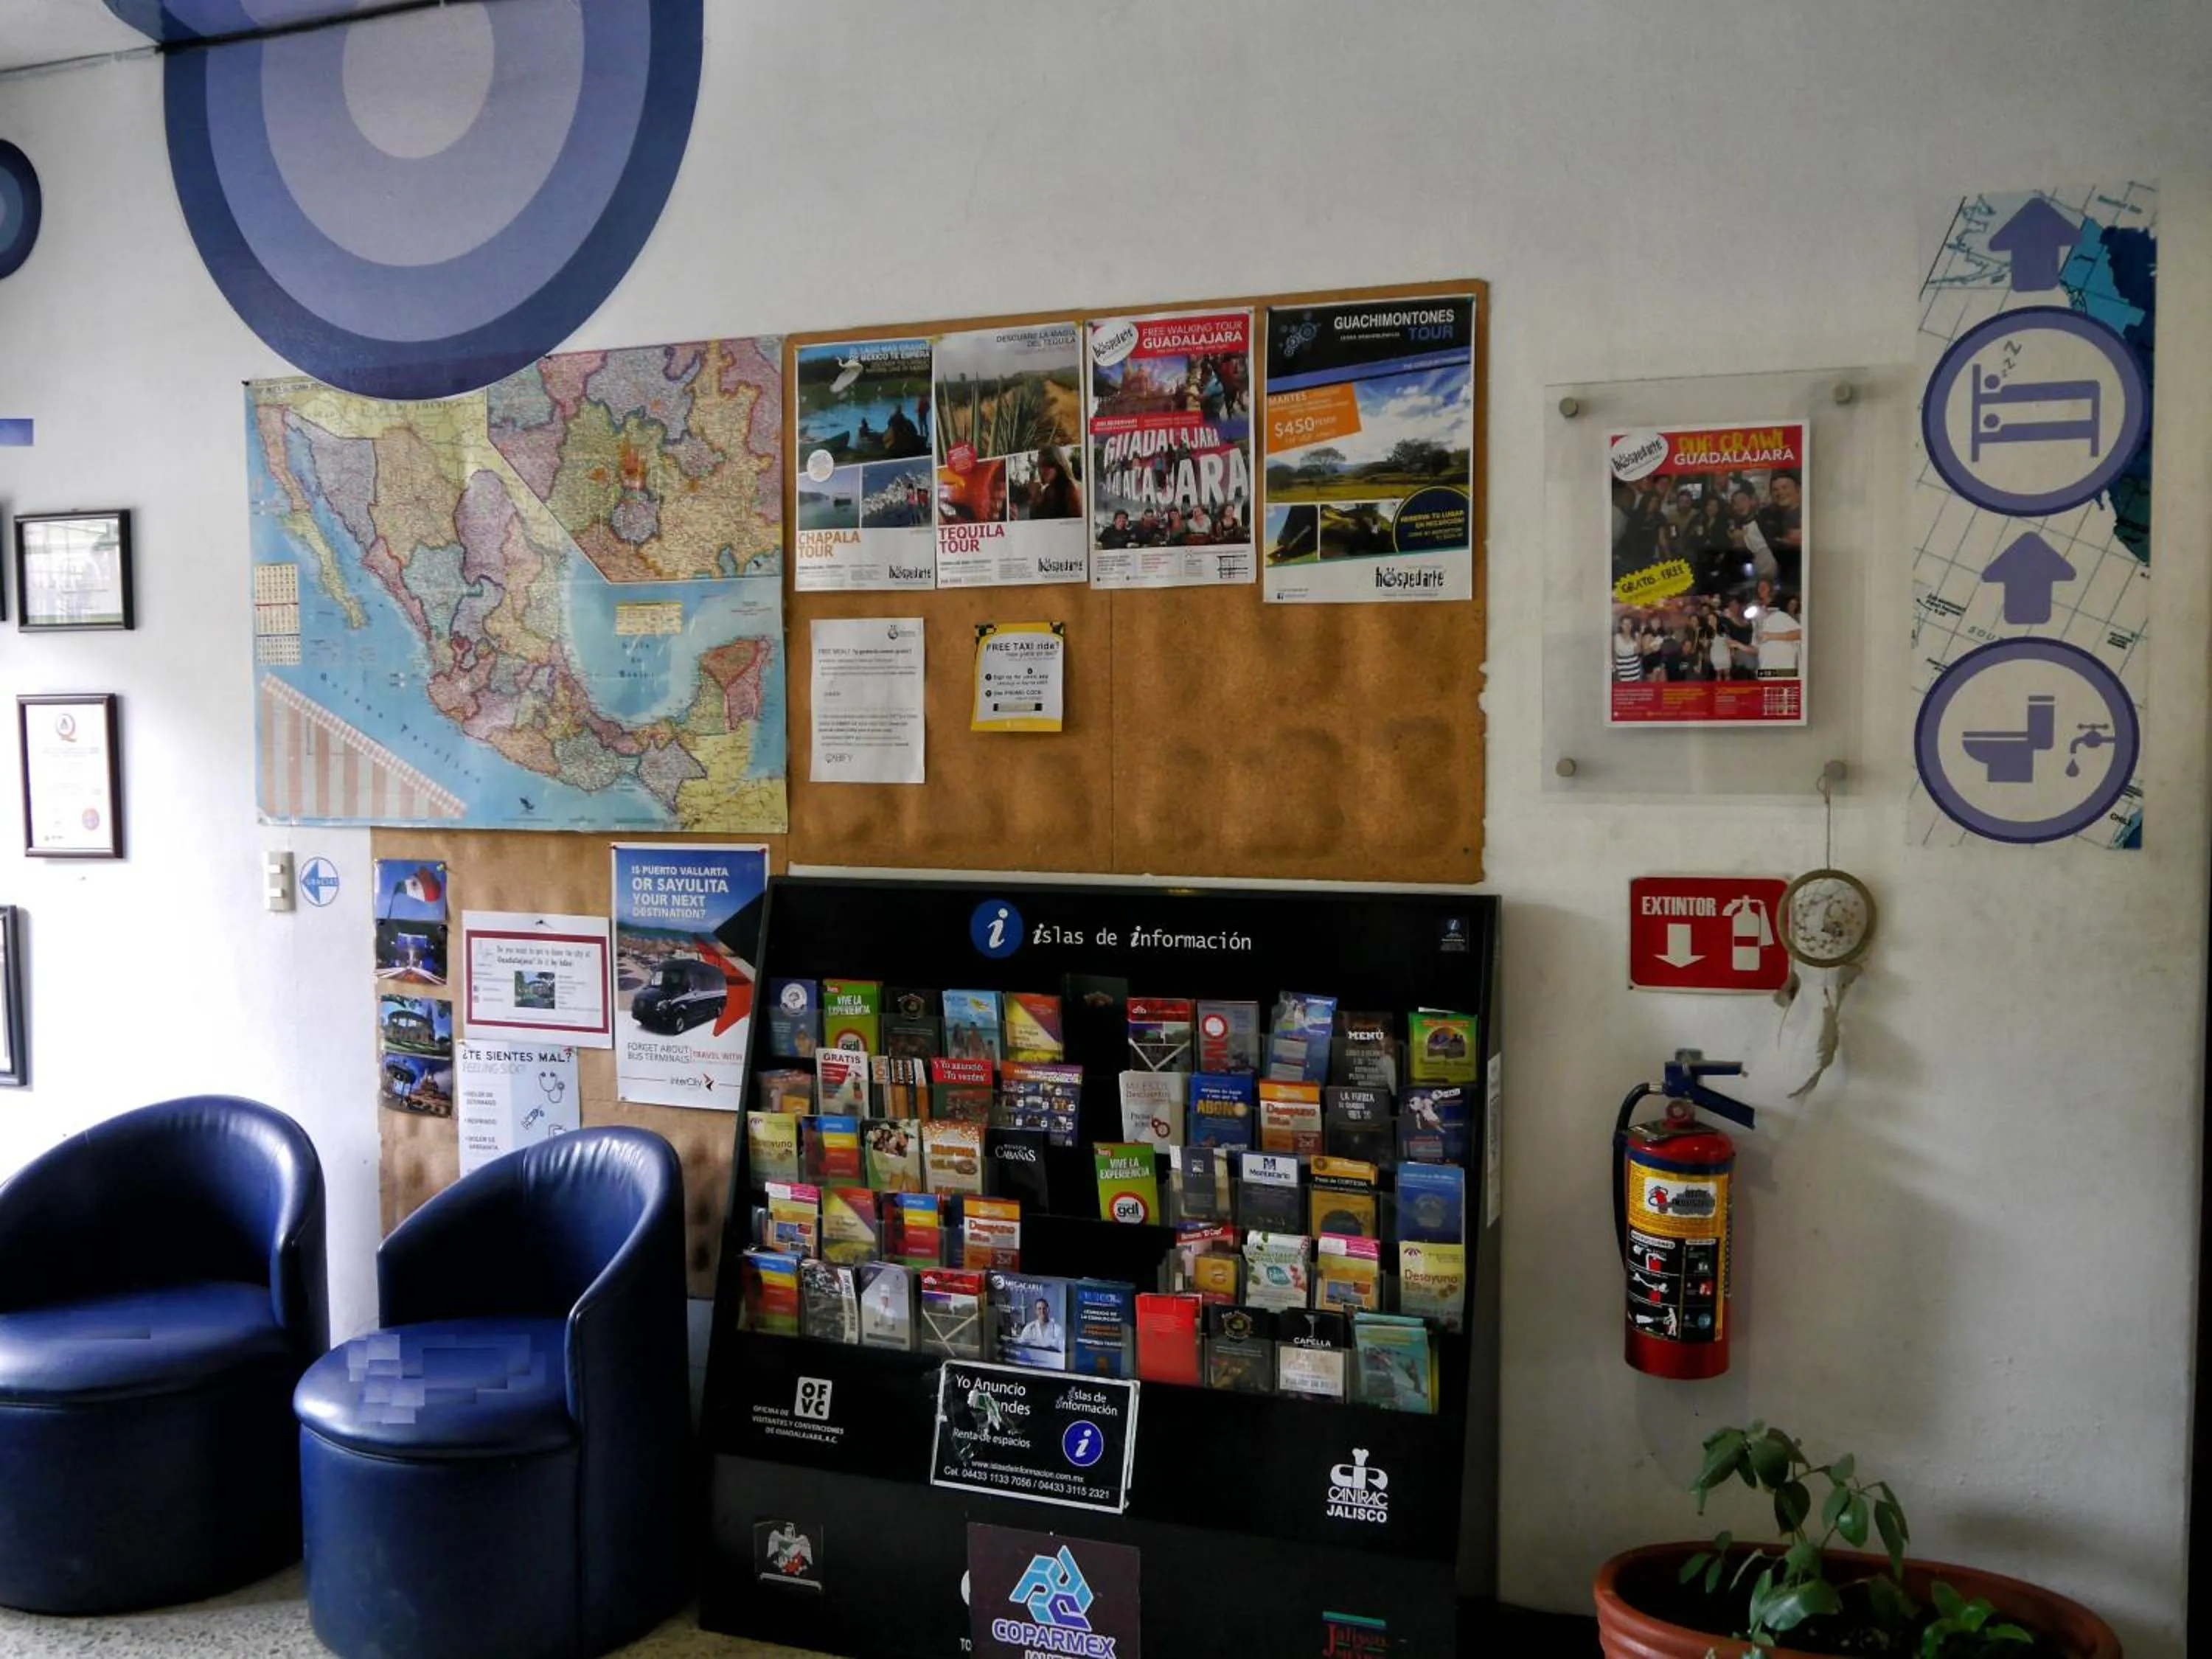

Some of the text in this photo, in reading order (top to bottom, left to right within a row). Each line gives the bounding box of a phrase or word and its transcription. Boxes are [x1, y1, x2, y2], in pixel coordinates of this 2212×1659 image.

[1334, 309, 1454, 330] GUACHIMONTONES
[1143, 321, 1242, 337] FREE WALKING TOUR
[1409, 324, 1453, 340] TOUR
[1144, 332, 1242, 349] GUADALAJARA
[1674, 448, 1795, 466] GUADALAJARA
[799, 530, 860, 545] CHAPALA
[939, 525, 1005, 540] TEQUILA
[799, 544, 834, 557] TOUR
[940, 539, 980, 554] TOUR
[986, 643, 1011, 651] FREE
[1013, 642, 1034, 651] TAXI
[631, 865, 729, 877] IS PUERTO VALLARTA
[632, 877, 729, 893] OR SAYULITA
[633, 894, 706, 906] YOUR NEXT
[1641, 896, 1717, 917] EXTINTOR
[632, 907, 706, 919] DESTINATION?
[1032, 922, 1252, 951] islas de información
[627, 1042, 689, 1054] FORGET ABOUT
[462, 1050, 571, 1062] ¿TE SIENTES MAL?
[627, 1051, 689, 1064] BUS TERMINALS
[824, 1053, 860, 1063] GRATIS
[1110, 1157, 1139, 1168] VIVE LA
[1099, 1167, 1150, 1179] EXPERIENCIA
[1116, 1202, 1139, 1217] gdl
[1405, 1269, 1458, 1284] Desayuno
[1293, 1336, 1332, 1347] CAPELLA
[956, 1374, 1026, 1396] Yo Anuncio
[1093, 1393, 1106, 1402] de
[953, 1427, 977, 1440] Renta
[992, 1434, 1030, 1449] espacios
[961, 1469, 987, 1481] 04433
[990, 1472, 1009, 1485] 1133
[1037, 1480, 1064, 1493] 04433
[1328, 1486, 1388, 1507] CANIRAC
[1326, 1504, 1387, 1523] JALISCO
[992, 1618, 1116, 1659] COPARMEX
